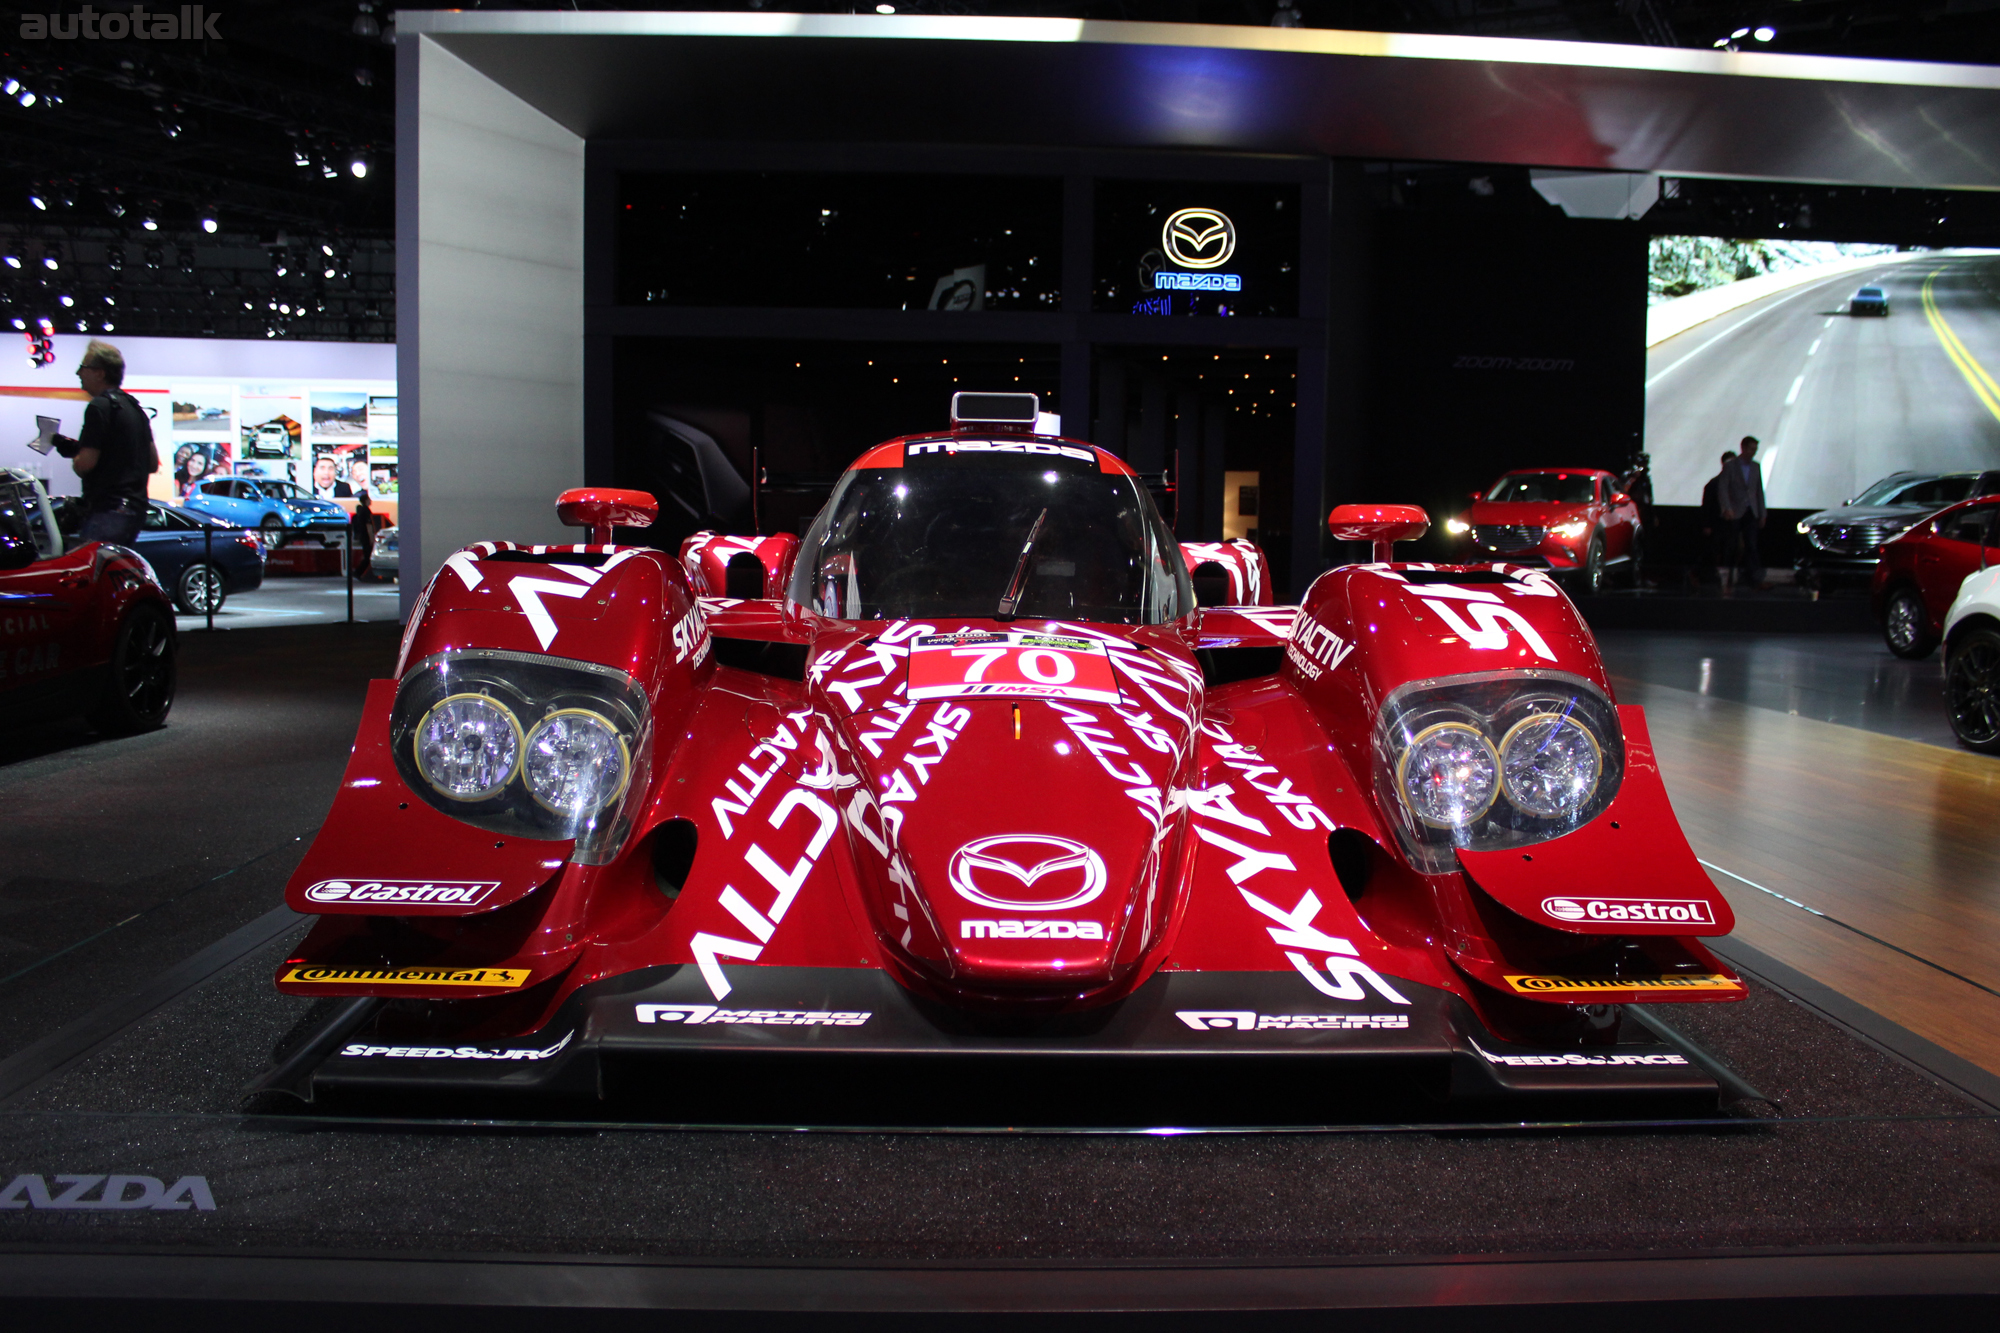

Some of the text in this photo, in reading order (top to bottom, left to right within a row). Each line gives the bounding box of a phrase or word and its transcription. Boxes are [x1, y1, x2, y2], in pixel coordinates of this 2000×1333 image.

[1155, 272, 1242, 291] mazda
[1452, 355, 1575, 371] zoom-zoom
[908, 440, 1095, 463] mazda
[14, 643, 61, 675] CAR
[951, 648, 1076, 685] 70
[995, 685, 1068, 696] IMSA
[349, 883, 482, 902] Castrol
[1587, 901, 1705, 921] Castrol
[961, 920, 1104, 940] mazda
[294, 966, 485, 982] Continental
[714, 1010, 872, 1019] MOTEGI
